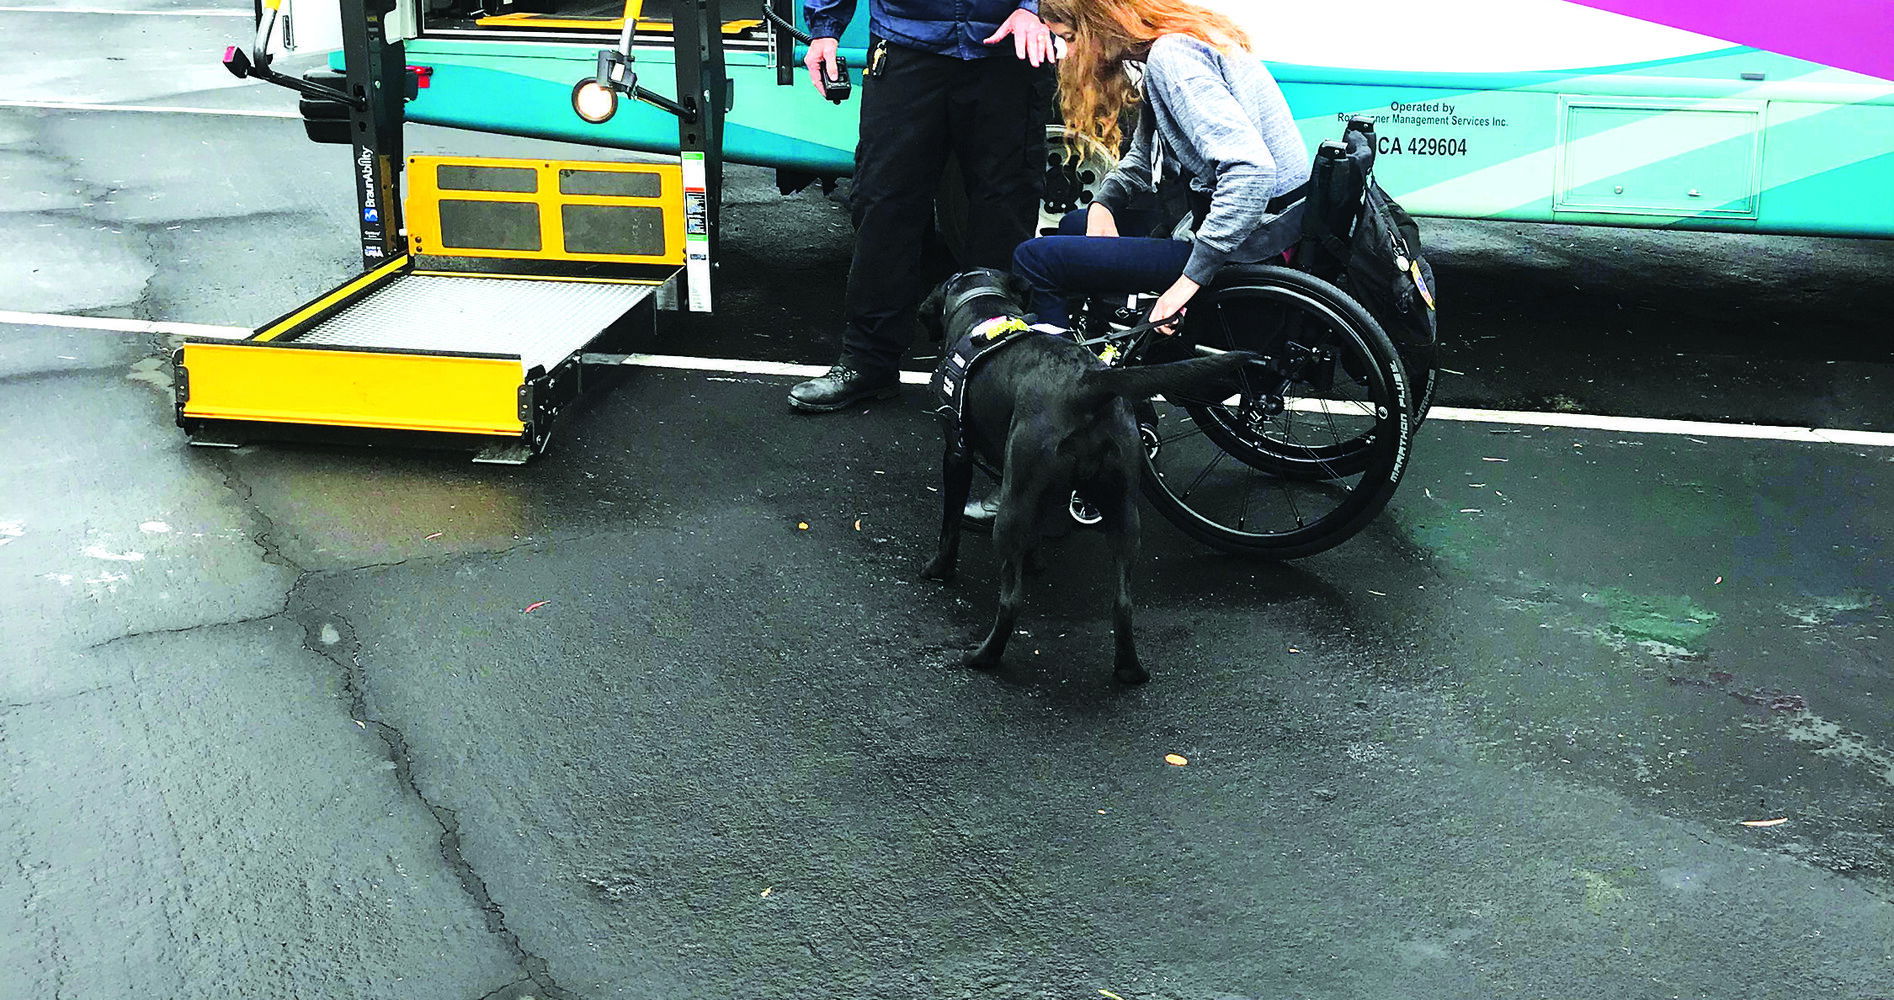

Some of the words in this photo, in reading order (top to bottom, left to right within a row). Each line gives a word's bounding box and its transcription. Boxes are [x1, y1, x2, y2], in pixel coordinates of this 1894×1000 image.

[1390, 101, 1439, 113] Operated
[1442, 102, 1456, 114] by
[1337, 112, 1389, 124] Roner
[1392, 113, 1449, 126] Management
[1451, 115, 1490, 127] Services
[1492, 116, 1509, 127] Inc.
[1378, 136, 1403, 155] CA
[1407, 137, 1467, 156] 429604
[357, 145, 376, 207] BraunAbility
[1389, 413, 1408, 483] MARATHON
